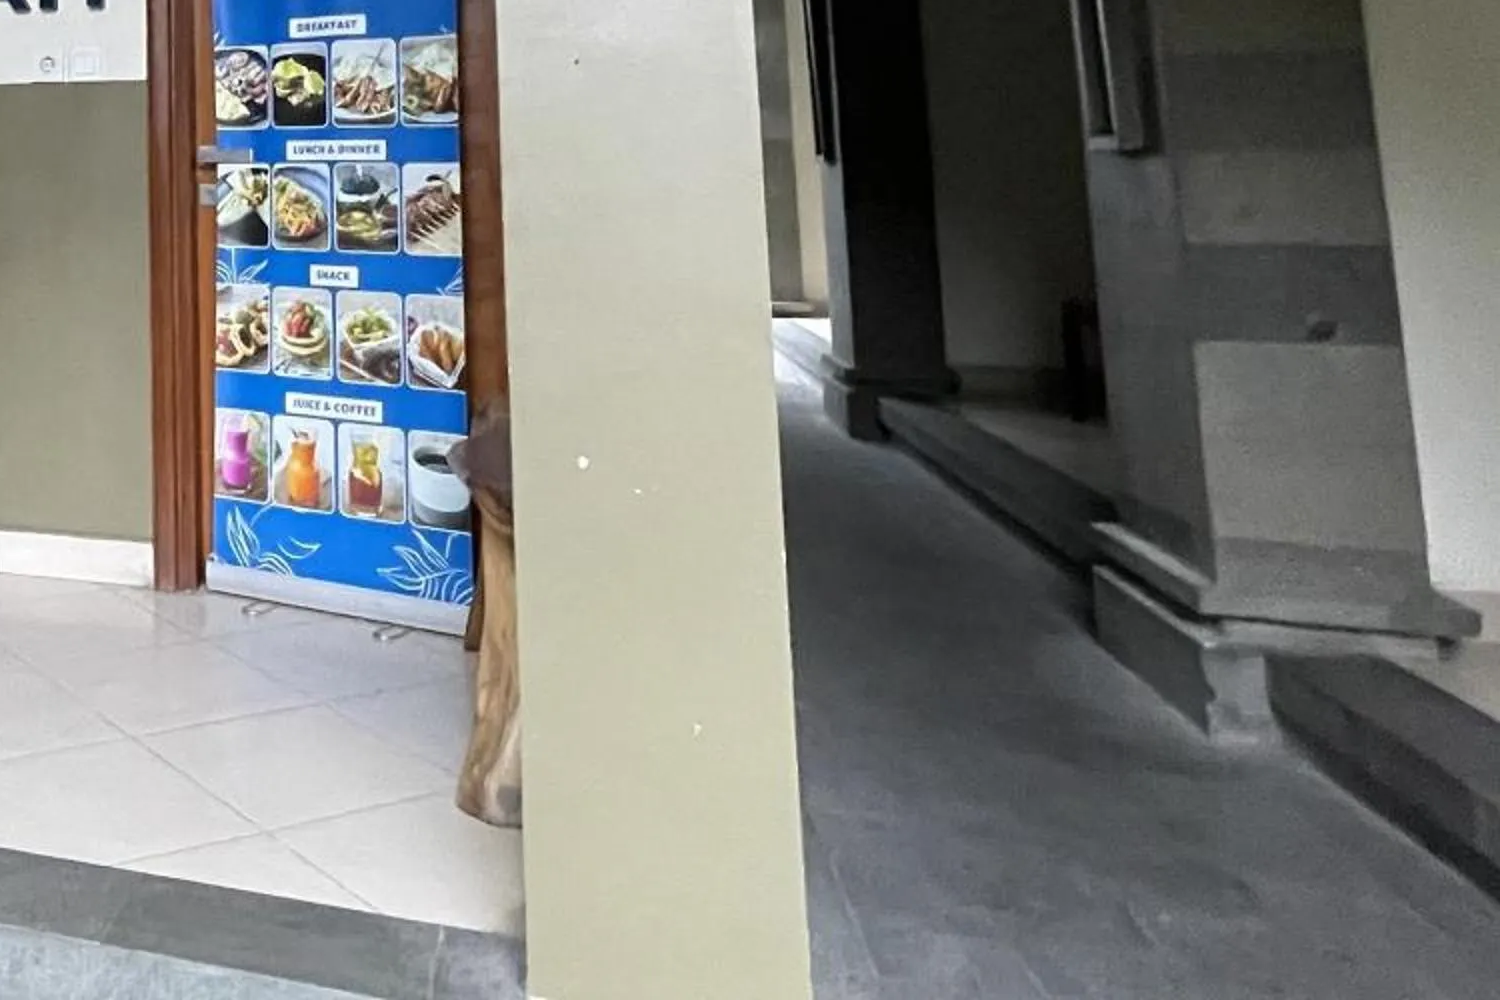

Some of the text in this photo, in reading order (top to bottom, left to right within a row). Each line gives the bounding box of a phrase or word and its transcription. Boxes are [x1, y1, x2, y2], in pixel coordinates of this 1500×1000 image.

[293, 144, 380, 155] LUNCH & DINNER
[316, 269, 350, 281] SNACK
[293, 399, 377, 416] JUICE & COFFEE
